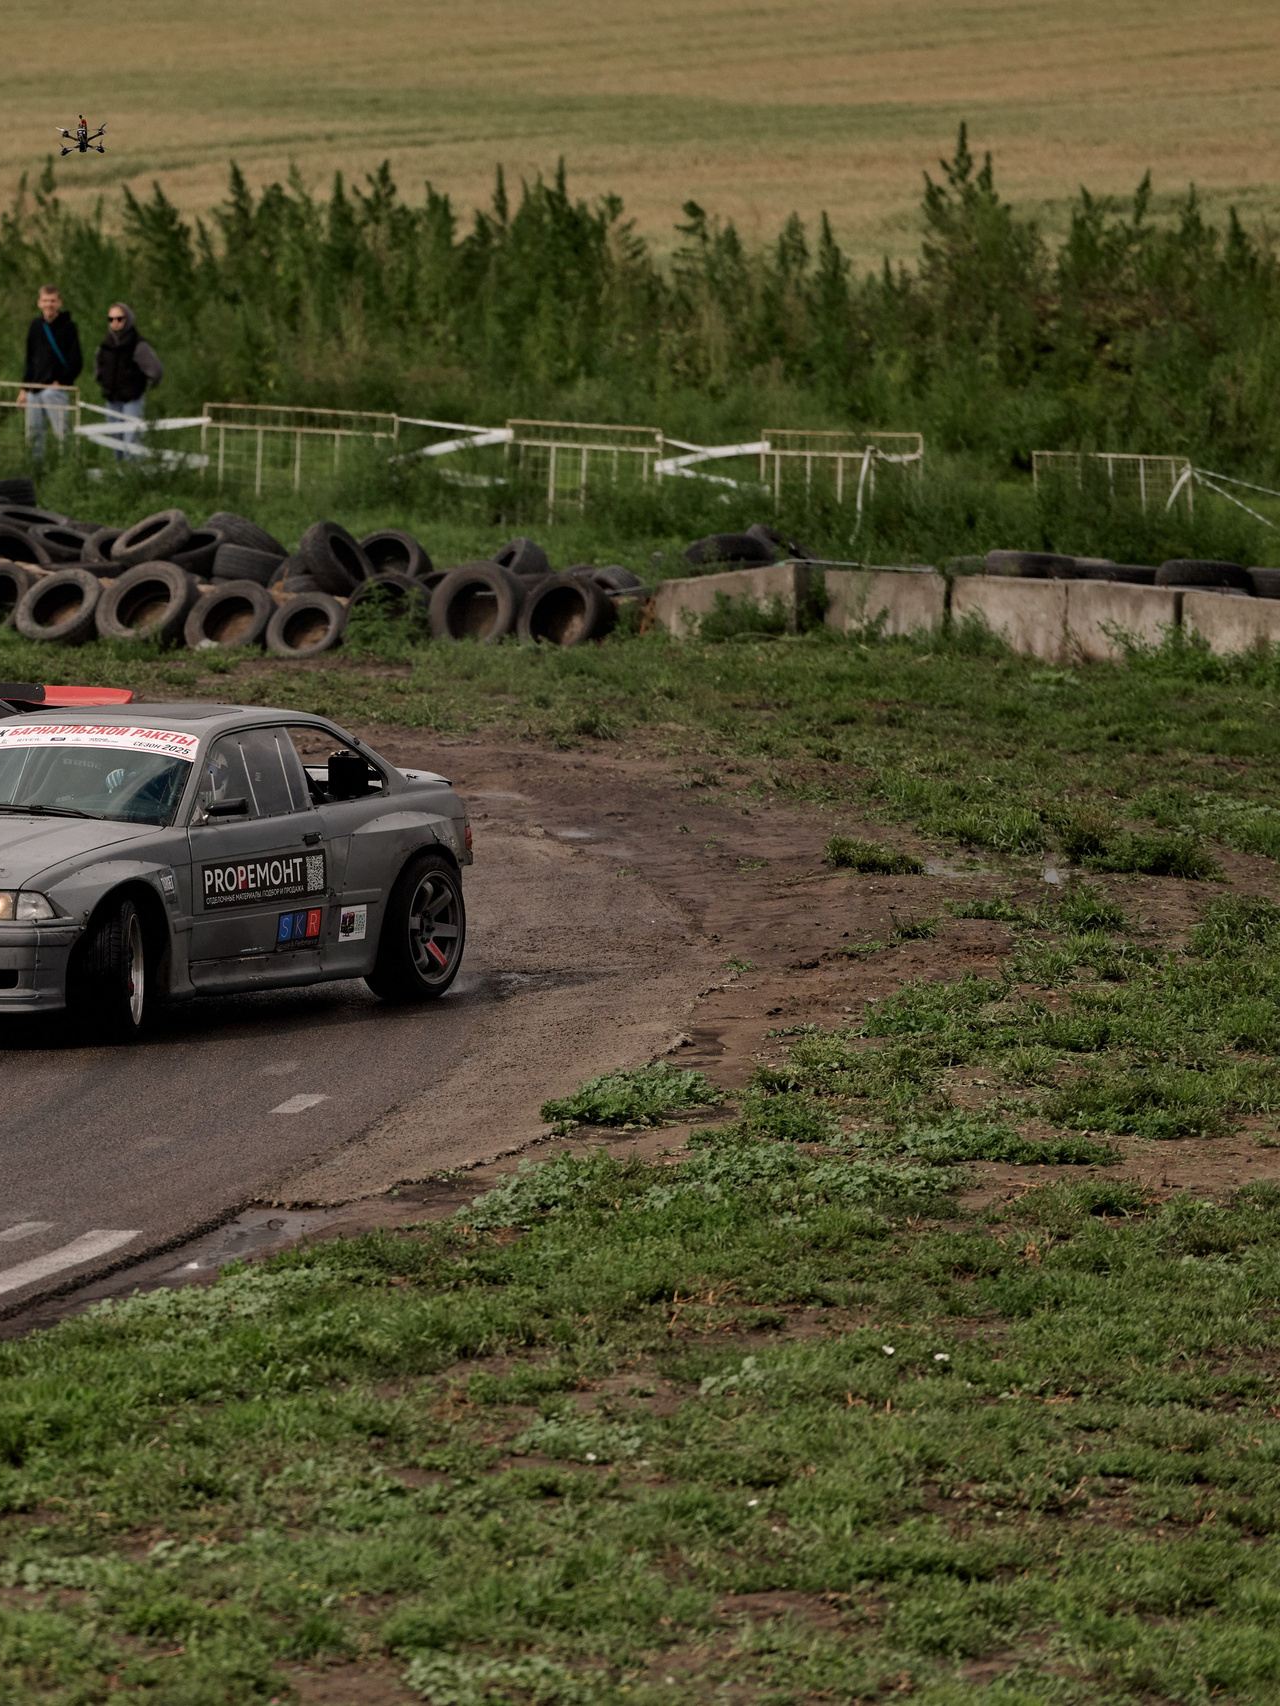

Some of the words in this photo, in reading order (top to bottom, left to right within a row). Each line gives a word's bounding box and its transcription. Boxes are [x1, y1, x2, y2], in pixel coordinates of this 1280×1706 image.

[130, 729, 197, 747] РАКЕТЫ
[133, 741, 161, 750] СЕЗОН
[161, 743, 191, 755] 2025
[280, 913, 318, 938] SKR
